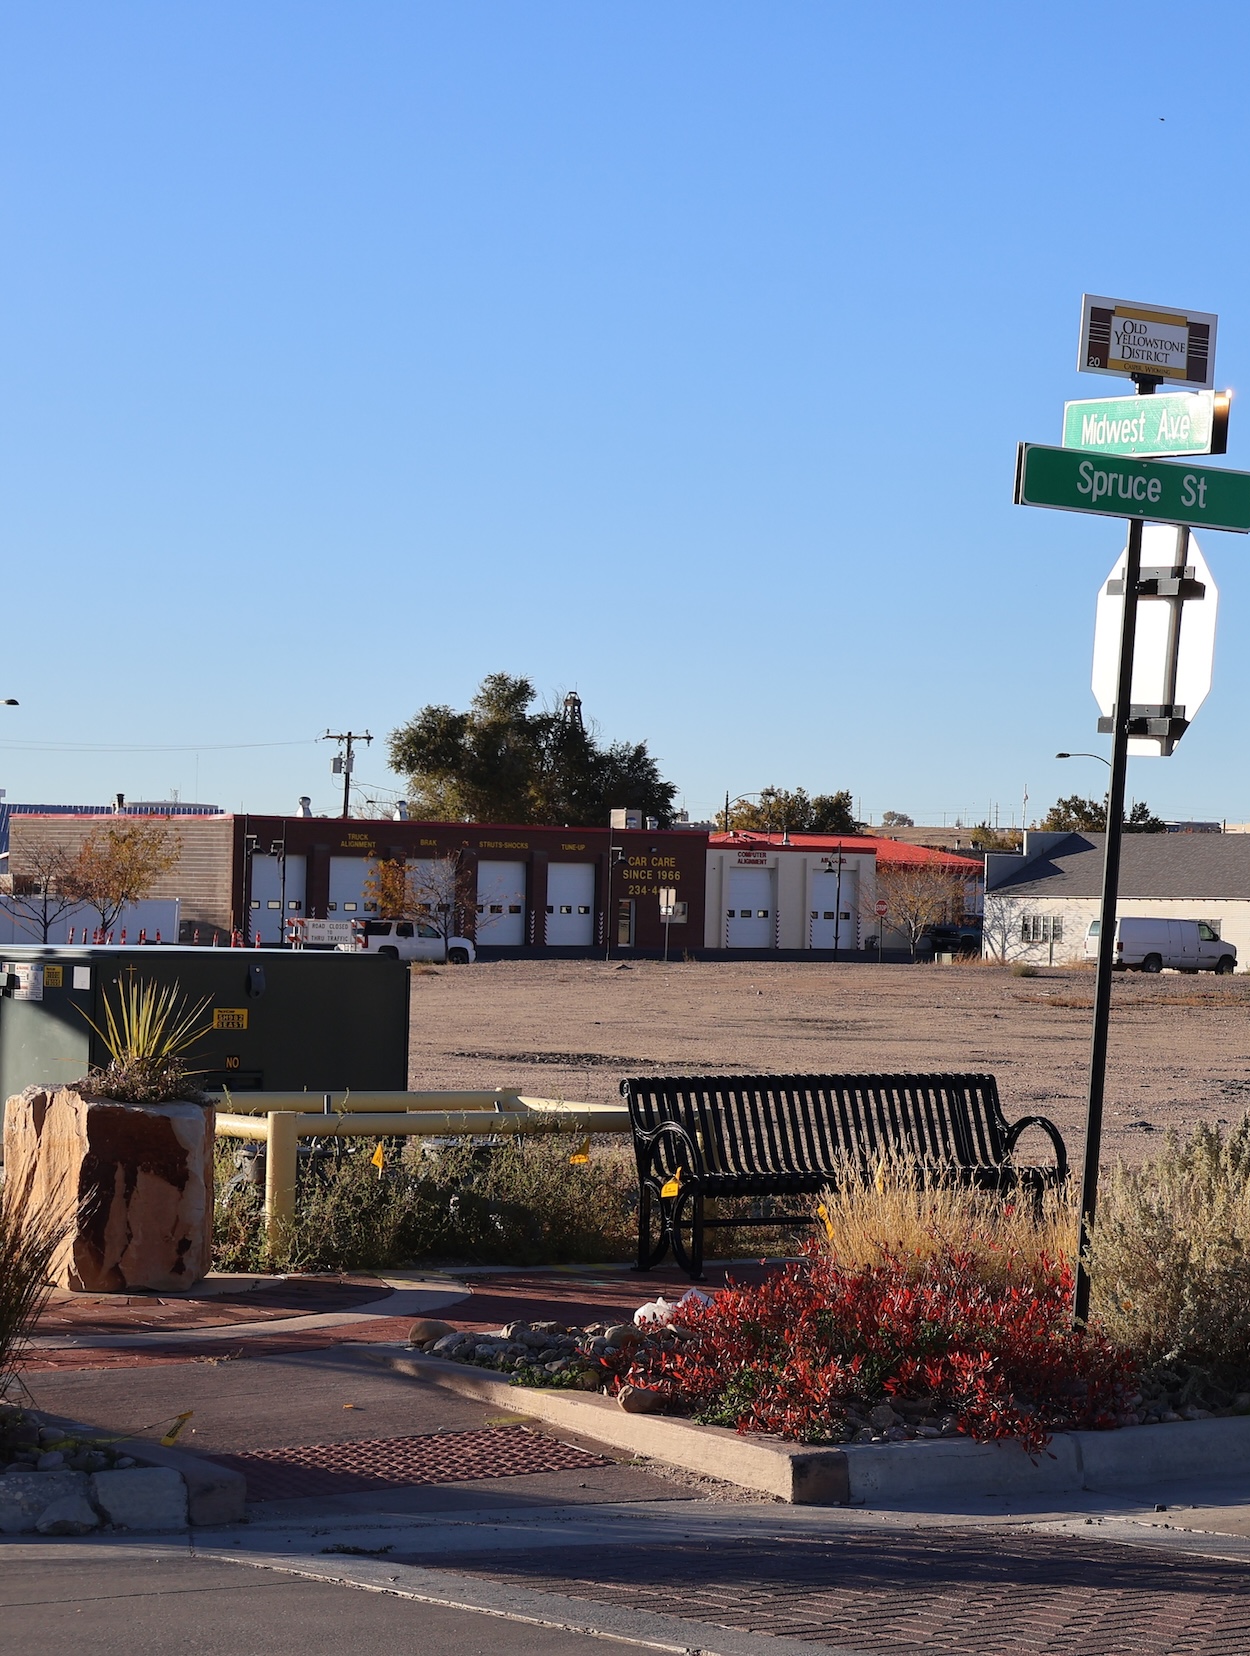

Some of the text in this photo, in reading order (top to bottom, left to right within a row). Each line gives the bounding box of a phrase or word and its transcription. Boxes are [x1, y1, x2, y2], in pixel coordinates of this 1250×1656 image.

[1114, 331, 1185, 353] YELLOWSTONE
[1121, 345, 1170, 363] DISTRICT
[1088, 356, 1100, 367] 20
[1081, 409, 1190, 446] Midwest Ave
[1076, 460, 1207, 509] Spruce St
[340, 840, 376, 848] ALIGNMENT
[561, 843, 586, 851] TUNE-UP
[628, 856, 676, 867] CAR CARE
[622, 869, 681, 881] SINCE 1966
[226, 1056, 240, 1069] NO
